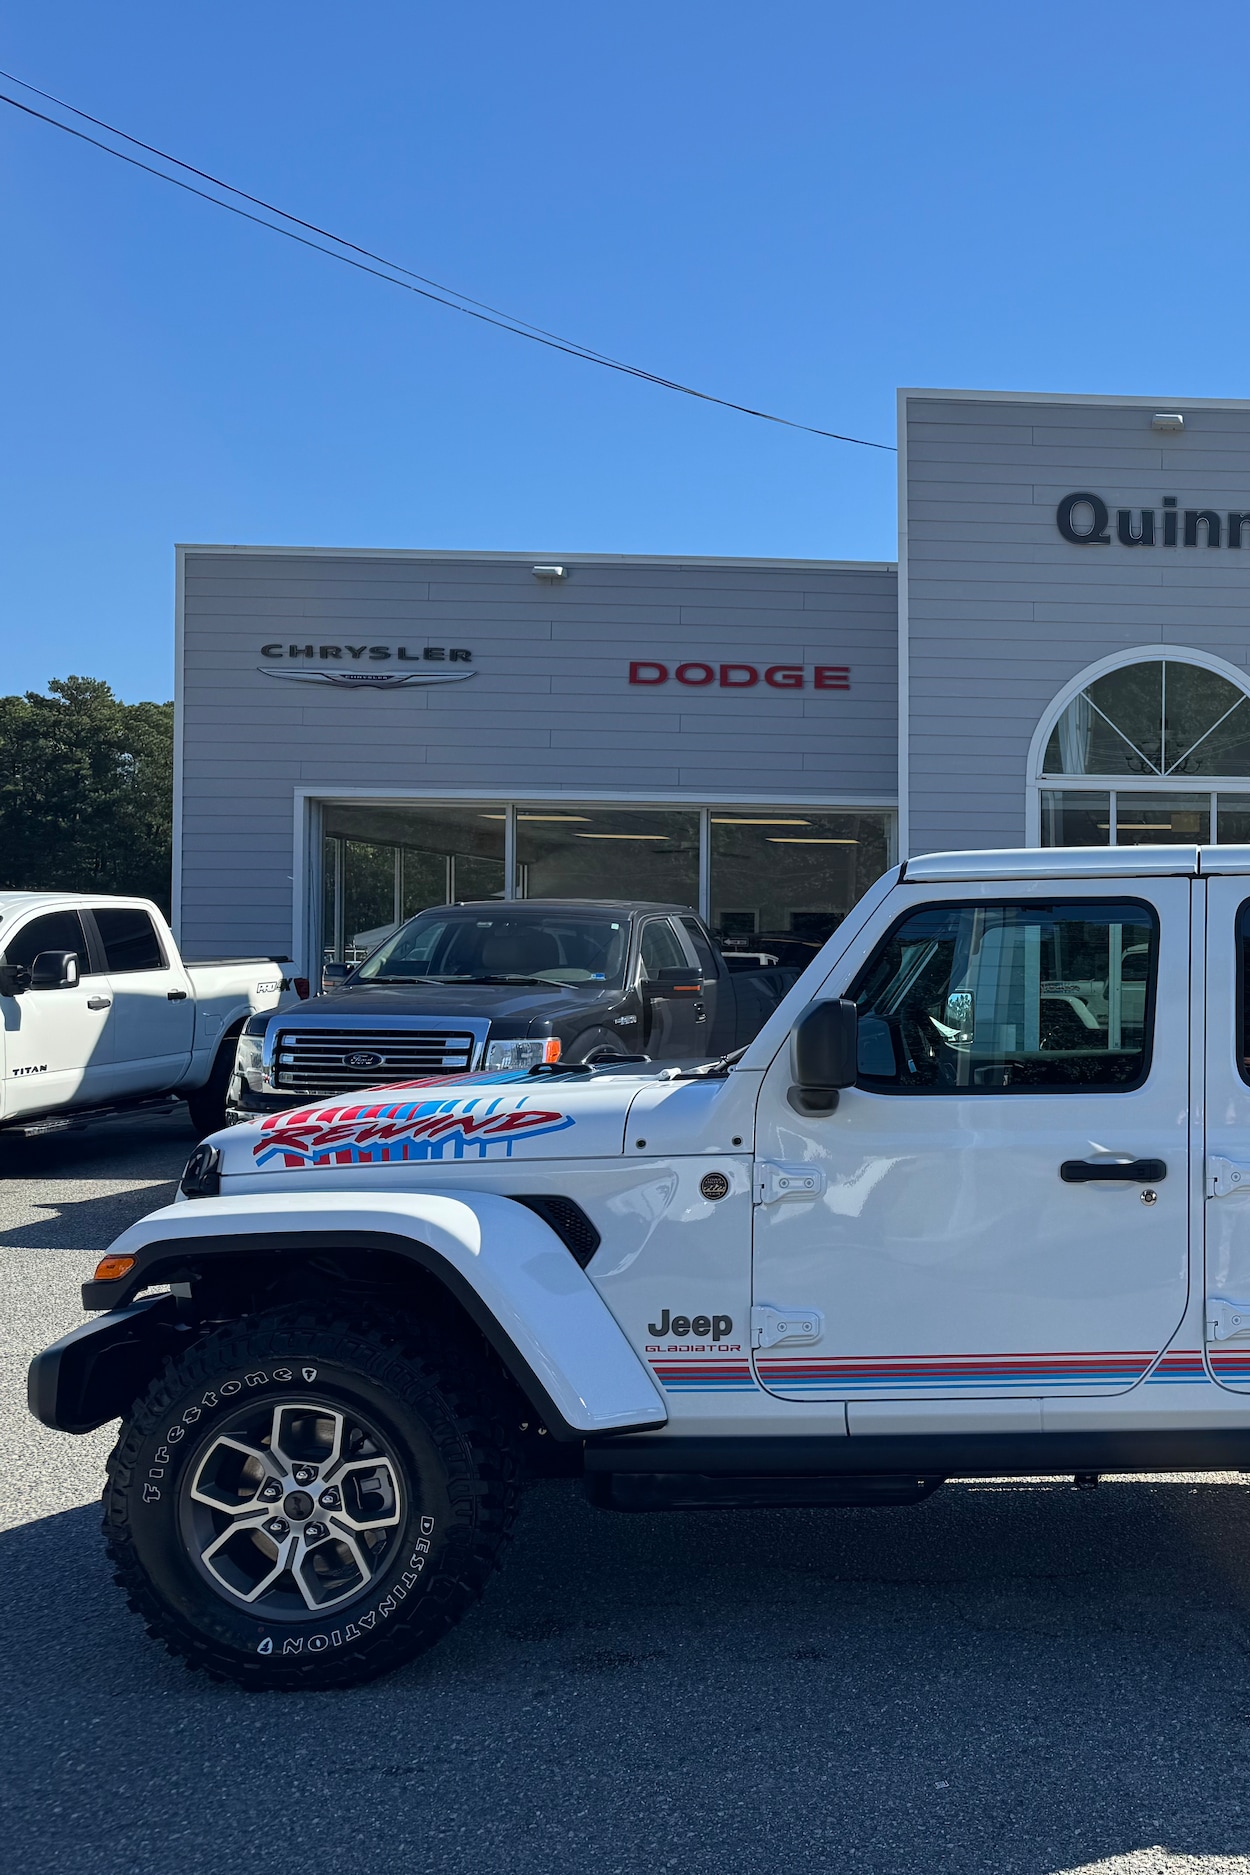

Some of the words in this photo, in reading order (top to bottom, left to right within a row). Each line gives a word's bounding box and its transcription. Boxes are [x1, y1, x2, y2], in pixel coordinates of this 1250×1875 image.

[260, 643, 473, 662] CHRYSLER
[629, 661, 850, 690] DODGE
[12, 1064, 48, 1076] TITAN
[350, 1054, 374, 1065] Ford
[252, 1110, 563, 1156] REWIND
[647, 1309, 733, 1342] Jeep
[645, 1345, 741, 1353] GLADIATOR
[143, 1367, 293, 1503] Firestone
[282, 1515, 435, 1655] DESTINATION
